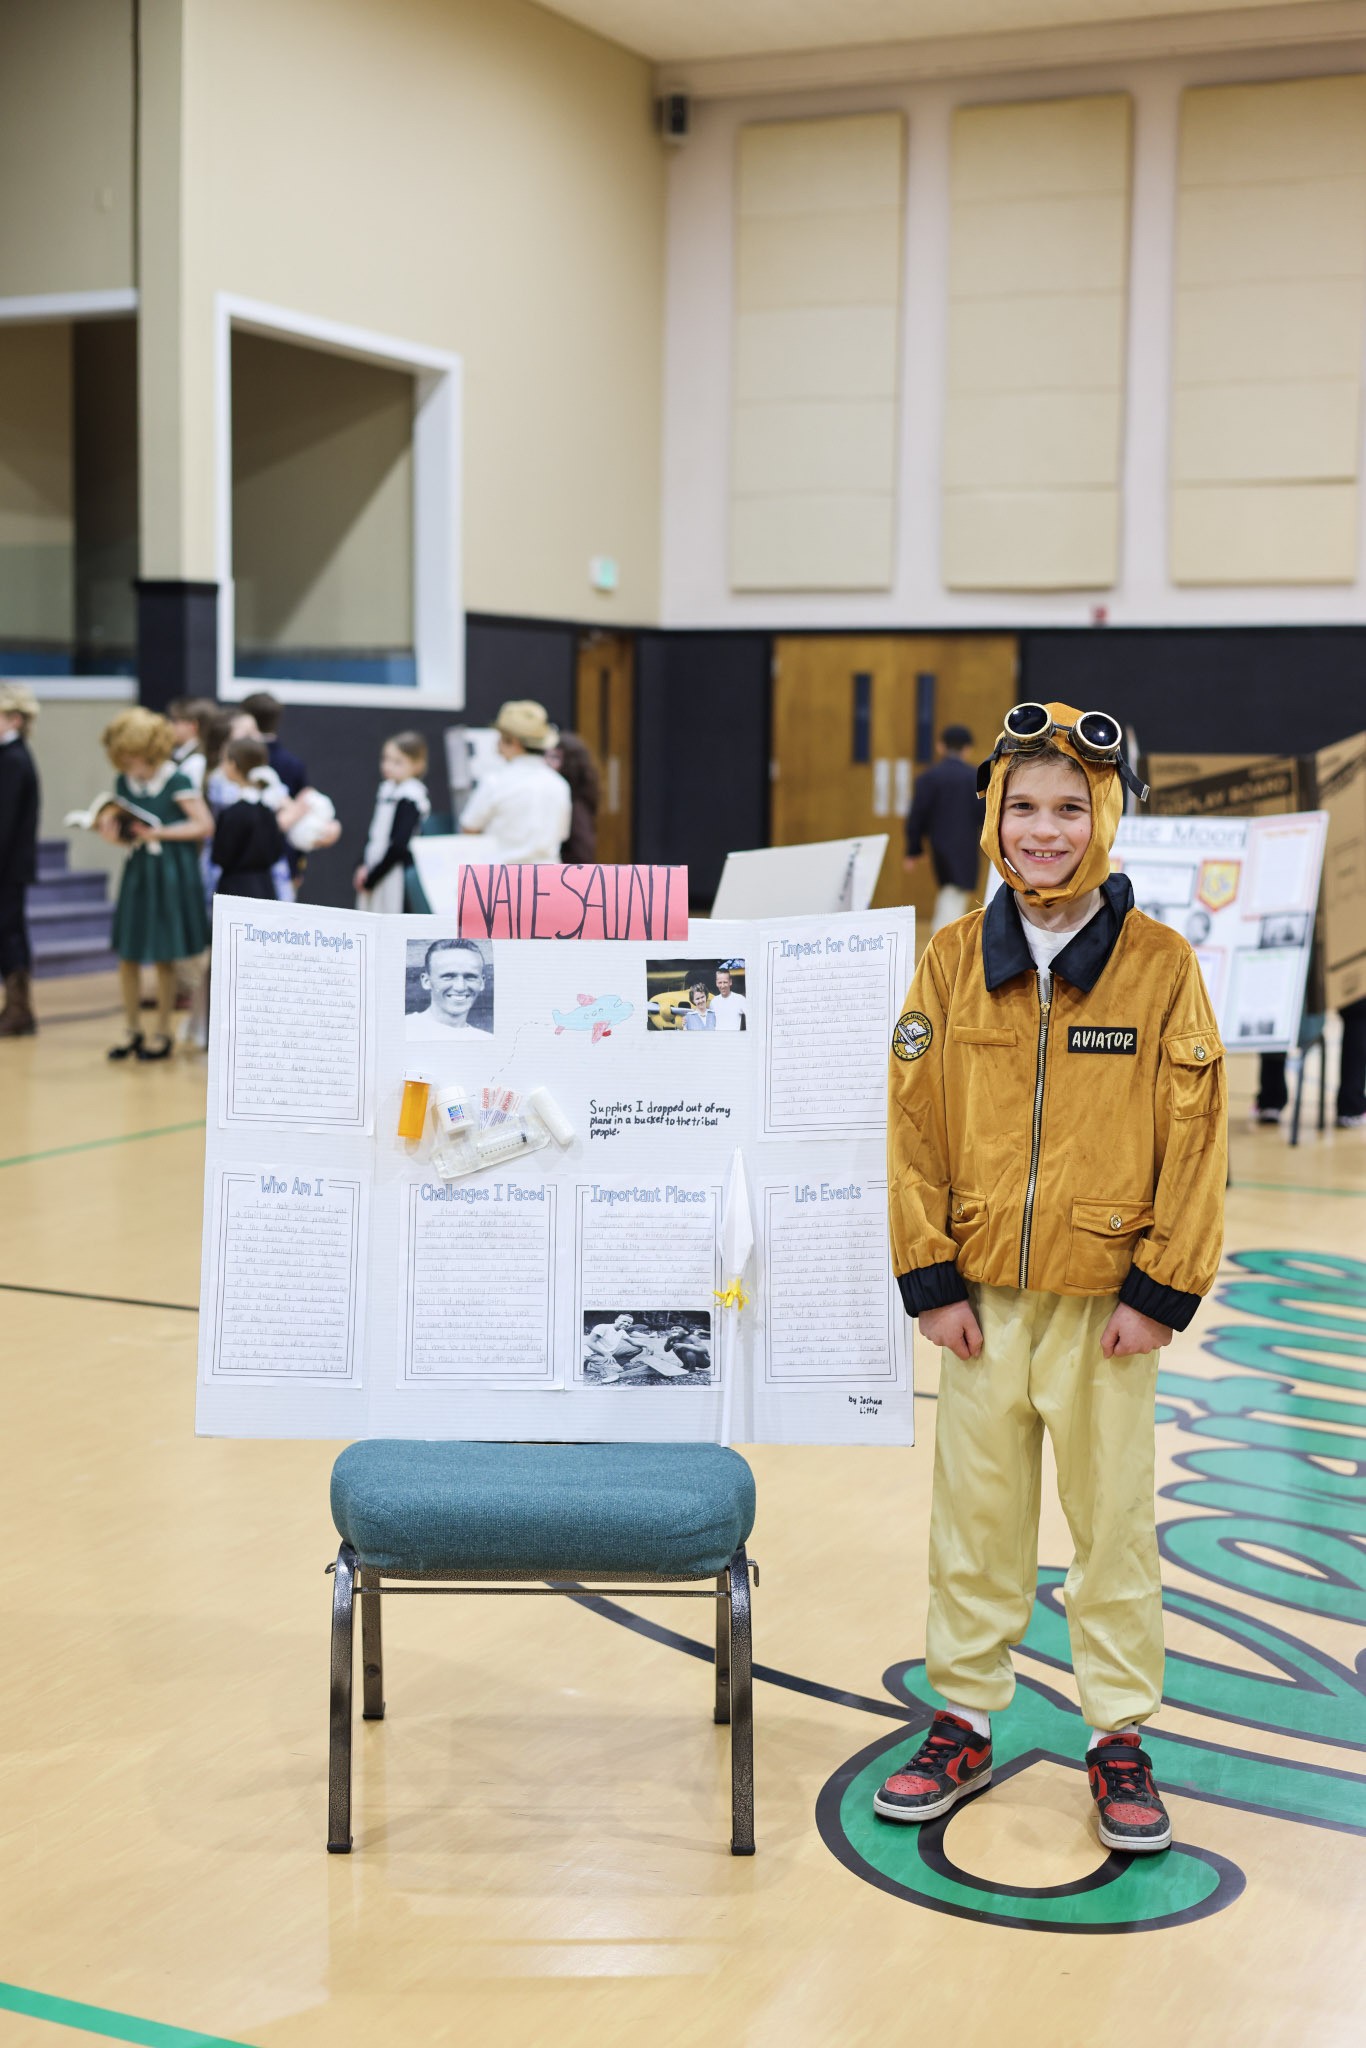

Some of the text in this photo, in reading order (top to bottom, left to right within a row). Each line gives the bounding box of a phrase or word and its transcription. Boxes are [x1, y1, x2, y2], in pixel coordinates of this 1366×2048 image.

[458, 864, 681, 941] NATE SAINT
[244, 923, 354, 952] Important People
[780, 934, 884, 960] Impact for Christ
[1072, 1030, 1134, 1050] AVIATOR
[590, 1099, 731, 1118] Supplies I dropped out of my
[590, 1115, 718, 1128] plane in a bucket to the tribal
[590, 1127, 620, 1140] people.
[261, 1175, 324, 1196] Who Am I
[420, 1183, 545, 1204] Challenges I Faced
[795, 1183, 862, 1202] Life Events
[591, 1185, 706, 1207] Important Places
[848, 1395, 882, 1405] by Joshua
[860, 1406, 878, 1415] Little
